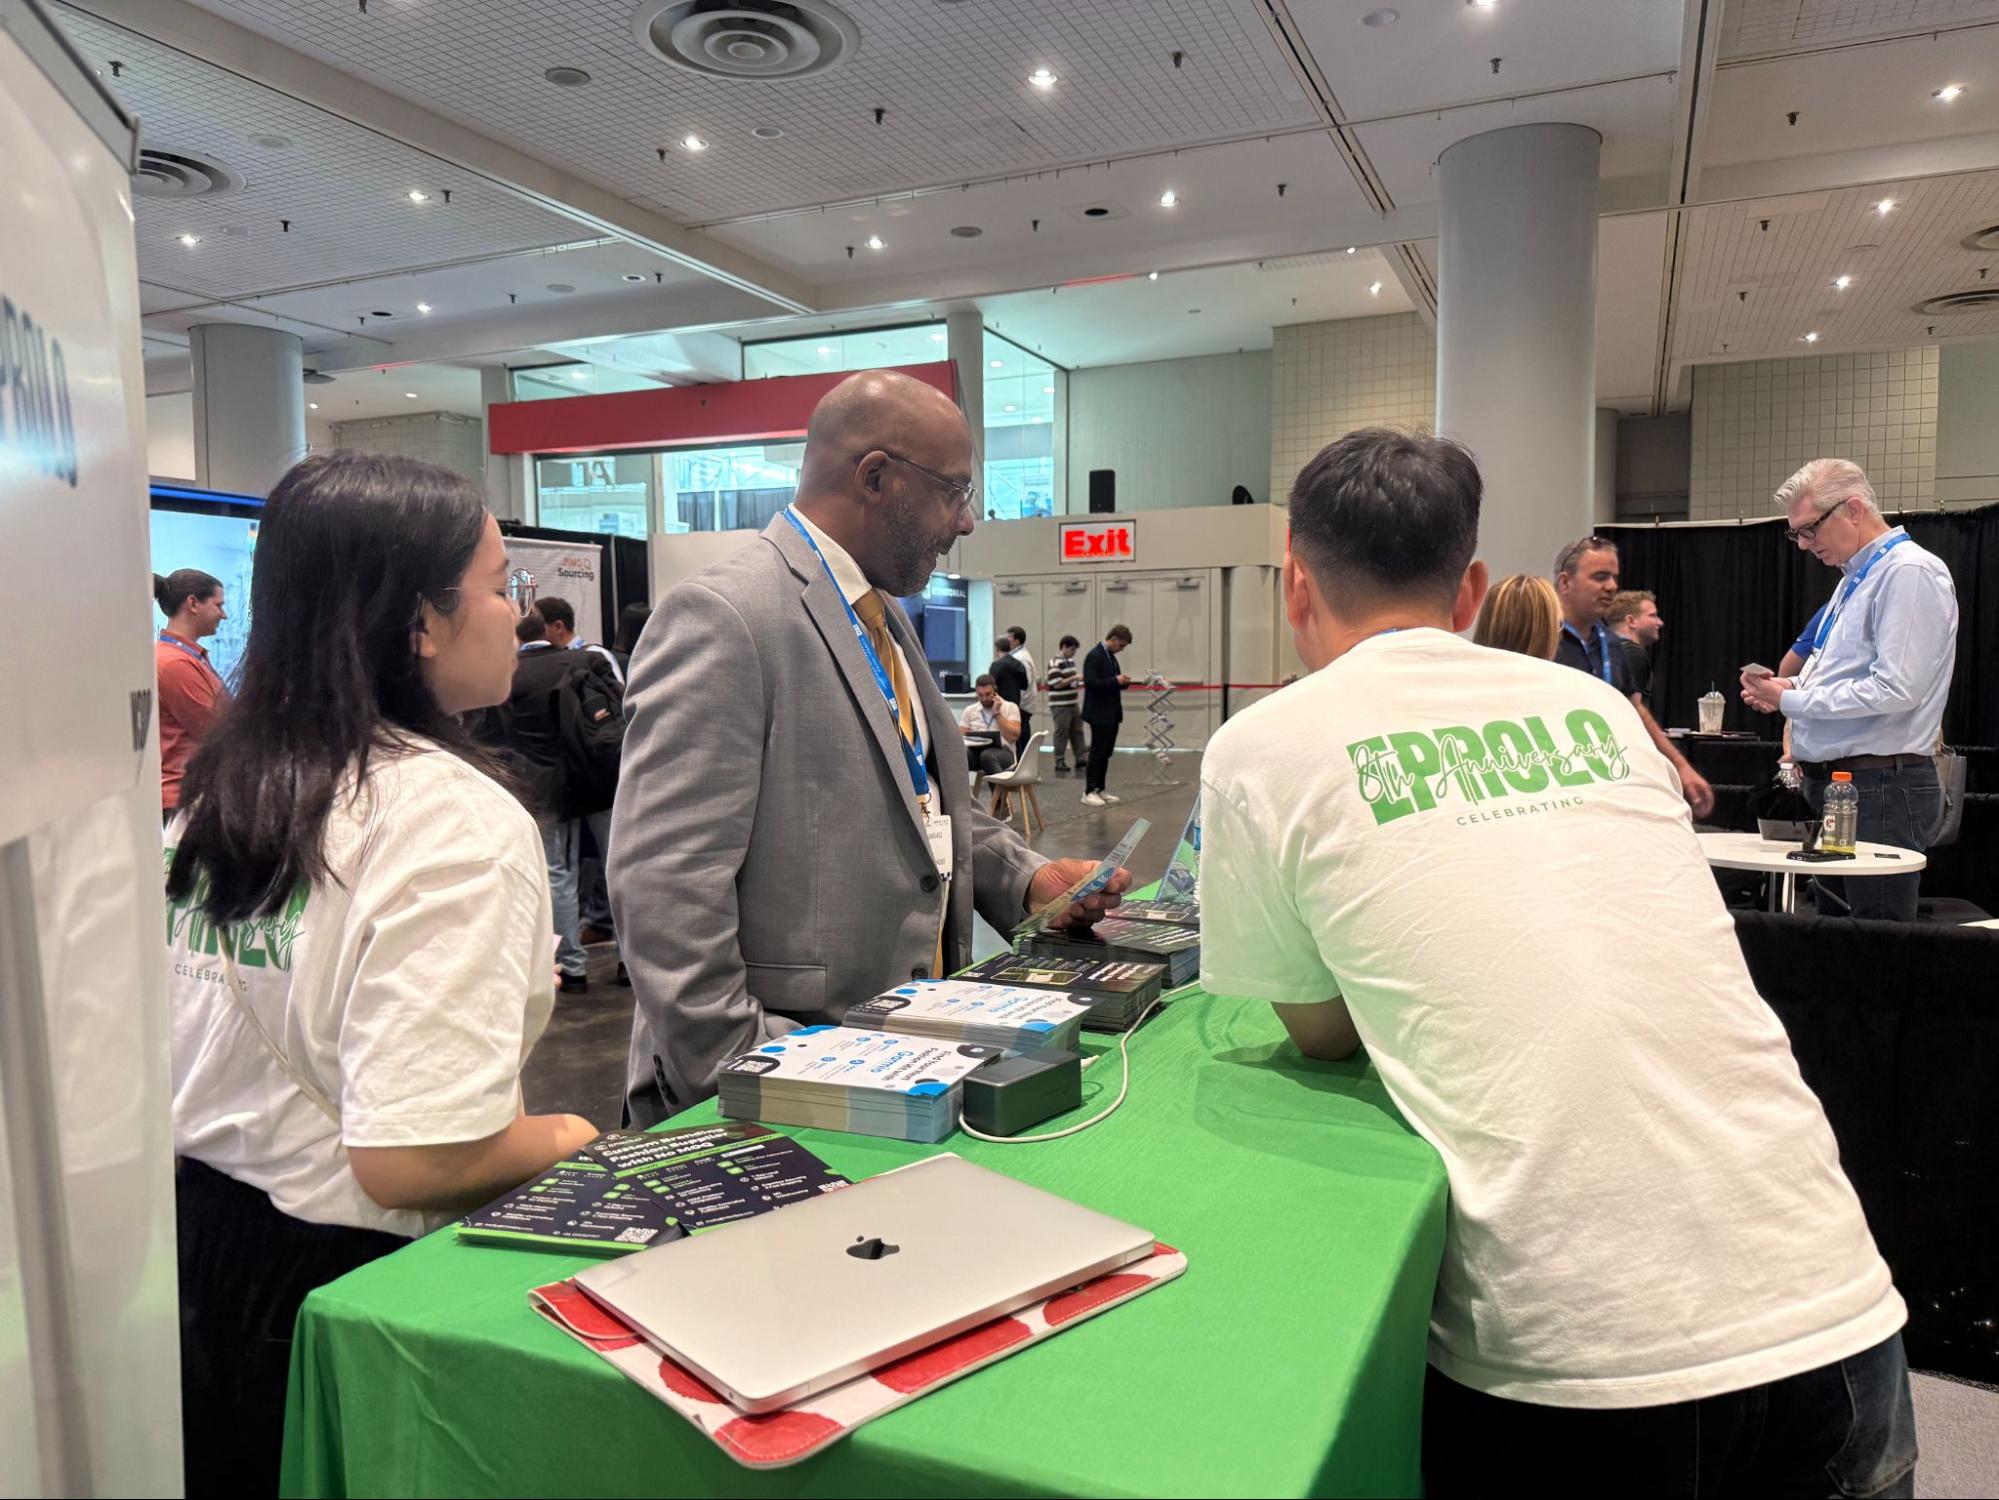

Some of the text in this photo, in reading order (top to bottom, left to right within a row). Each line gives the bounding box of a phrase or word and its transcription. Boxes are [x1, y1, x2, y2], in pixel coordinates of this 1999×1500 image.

[1065, 528, 1131, 558] Exit
[558, 567, 594, 581] Sourcing
[1346, 708, 1624, 826] EPROLO
[1436, 734, 1630, 805] Anniversary
[1456, 795, 1585, 826] CELEBRATING
[602, 1127, 725, 1156] Custom Branding
[608, 1145, 669, 1162] Fashion
[669, 1131, 728, 1148] Supplier
[617, 1155, 654, 1168] with
[654, 1150, 676, 1159] No
[676, 1141, 715, 1154] MOQ
